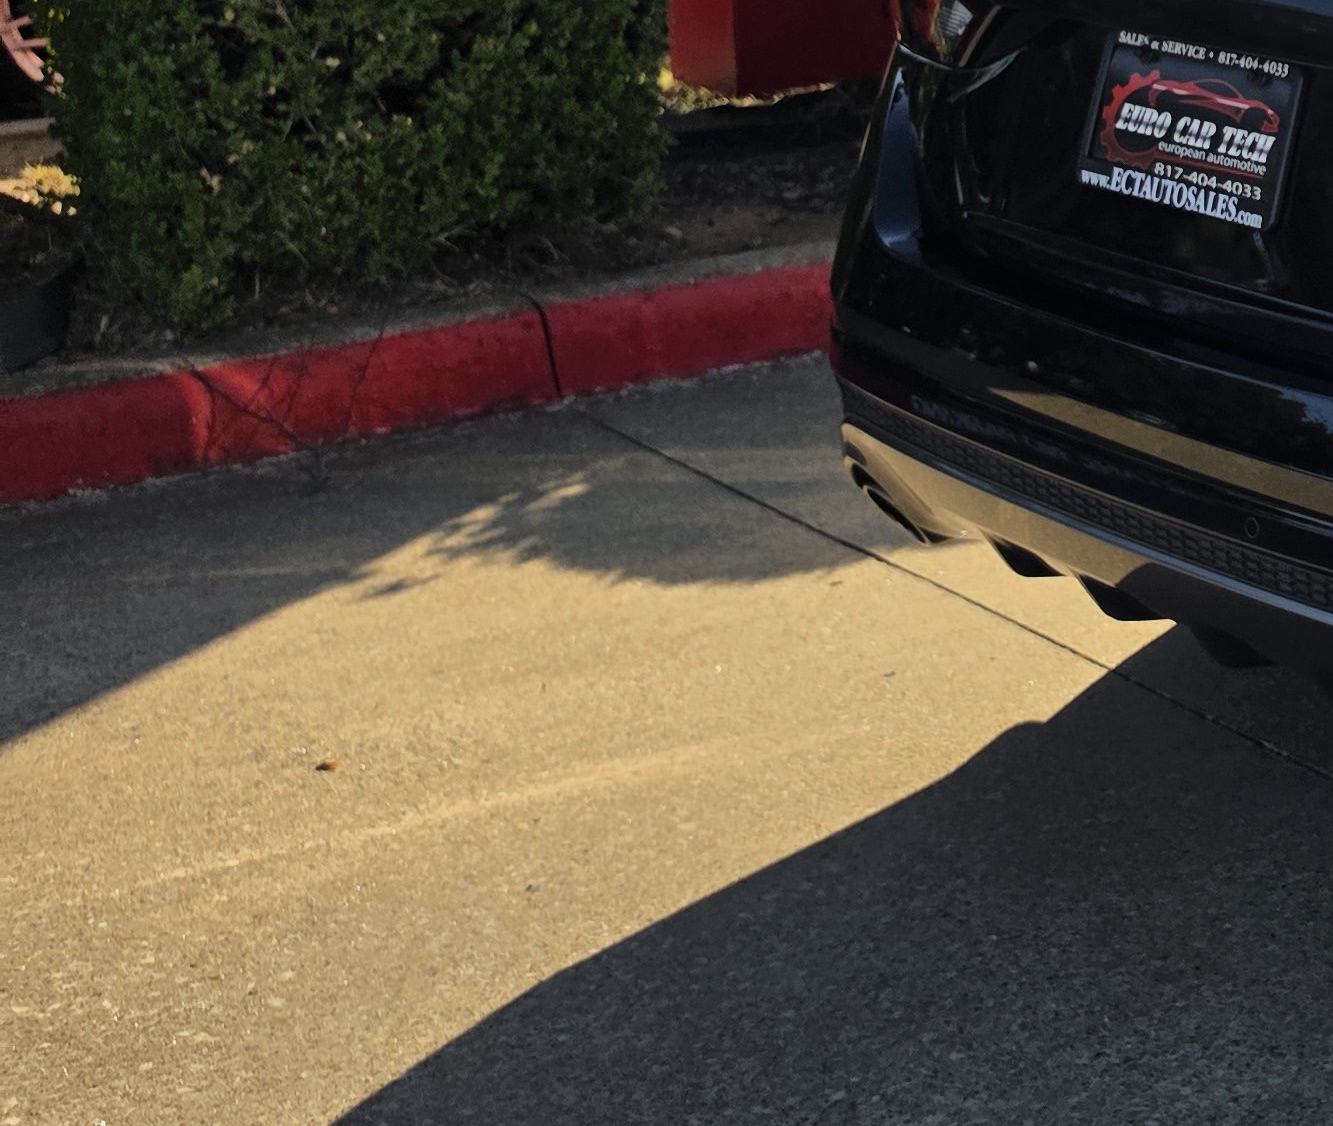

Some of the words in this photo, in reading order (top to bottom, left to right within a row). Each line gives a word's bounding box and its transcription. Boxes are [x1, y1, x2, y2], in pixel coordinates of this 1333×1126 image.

[1161, 40, 1206, 60] SERVICE
[1218, 51, 1289, 78] 817-404-4033
[1115, 102, 1172, 138] EURO
[1173, 116, 1217, 149] CAR
[1217, 125, 1276, 164] TECH
[1158, 140, 1206, 161] european
[1206, 154, 1267, 176] automotive
[1080, 166, 1263, 229] www.ECTAUTOSALES.com
[1153, 162, 1262, 201] 817-404-4033
